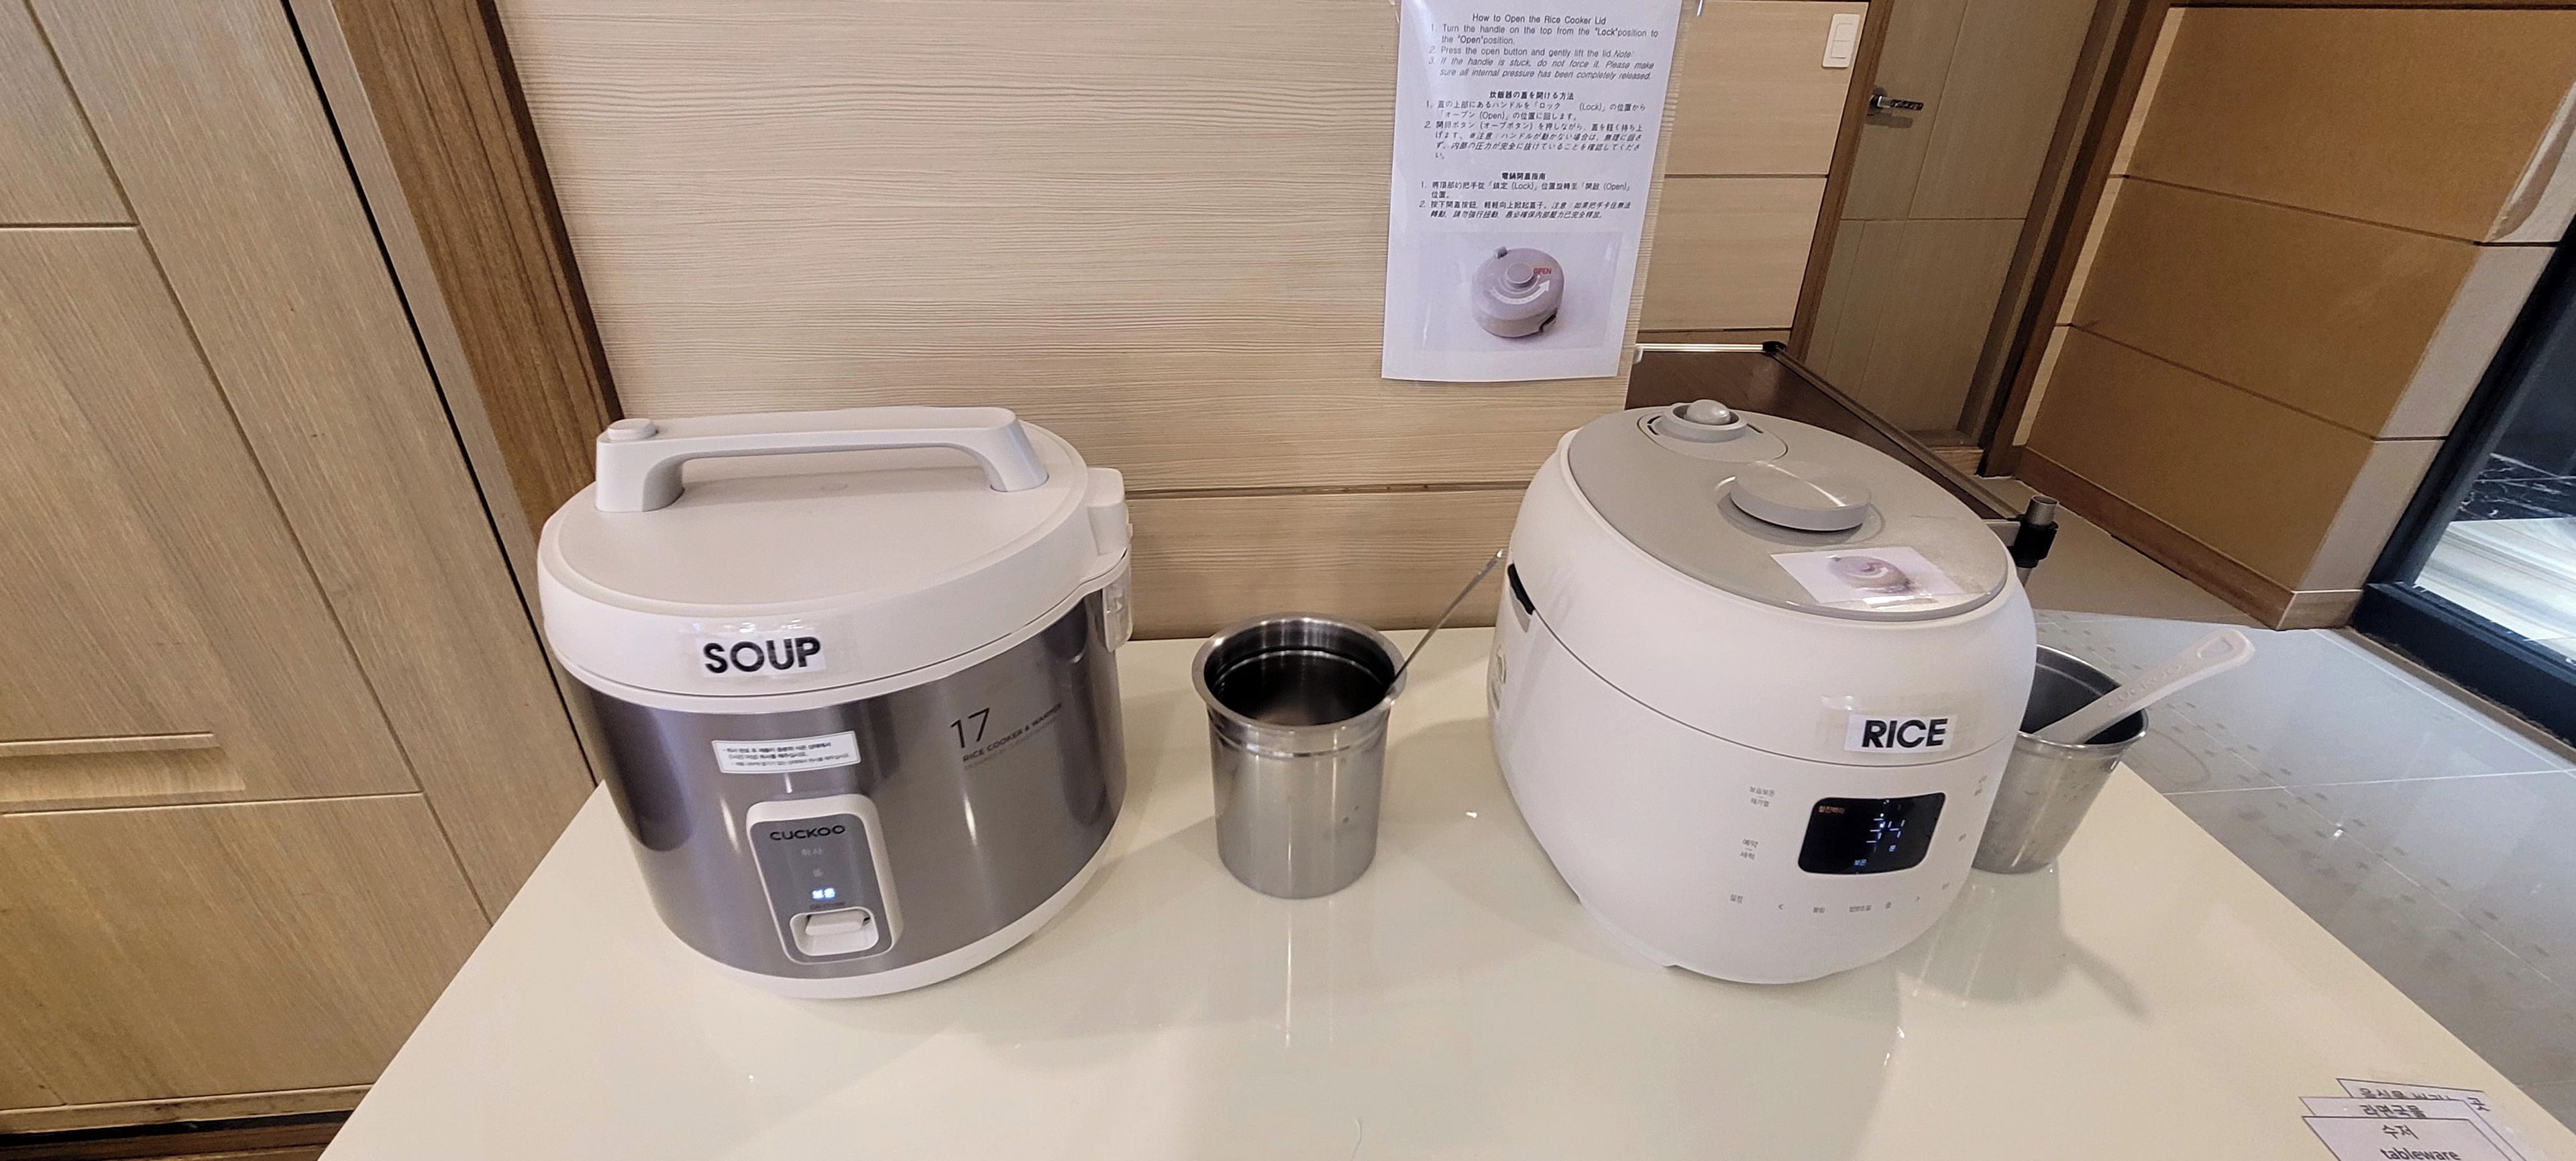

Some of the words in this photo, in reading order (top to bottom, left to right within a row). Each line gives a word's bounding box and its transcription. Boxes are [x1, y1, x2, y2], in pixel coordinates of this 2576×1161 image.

[1472, 13, 1489, 21] How
[1493, 14, 1501, 22] to
[1505, 14, 1525, 23] Open
[1544, 15, 1560, 23] Rice
[1564, 15, 1591, 24] Cooker
[1595, 17, 1606, 25] Lid
[1443, 24, 1459, 32] Turn
[1480, 25, 1505, 34] handle
[1540, 27, 1552, 35] top
[1557, 27, 1574, 35] from
[1578, 28, 1590, 36] the
[1651, 30, 1658, 38] to
[1441, 46, 1461, 54] Press
[1481, 48, 1500, 56] open
[1504, 48, 1527, 56] button
[1549, 49, 1571, 58] gently
[1574, 49, 1583, 57] lift
[1603, 50, 1611, 58] lid
[1468, 57, 1493, 66] handle
[1570, 60, 1589, 68] force
[1606, 61, 1630, 69] Please
[1459, 68, 1468, 77] all
[1471, 68, 1500, 77] internal
[1502, 70, 1535, 78] pressure
[1554, 70, 1574, 79] been
[1576, 70, 1617, 81] completely
[1619, 72, 1651, 80] released.
[703, 636, 820, 674] SOUP
[951, 707, 990, 748] 17
[1862, 718, 1948, 748] RICE
[963, 748, 984, 762] RICE
[987, 729, 1023, 752] COOKER
[770, 825, 845, 841] CUCKOO
[2359, 1105, 2427, 1119] 라면국물
[2382, 1124, 2419, 1140] 수저
[2380, 1147, 2461, 1161] tableware
